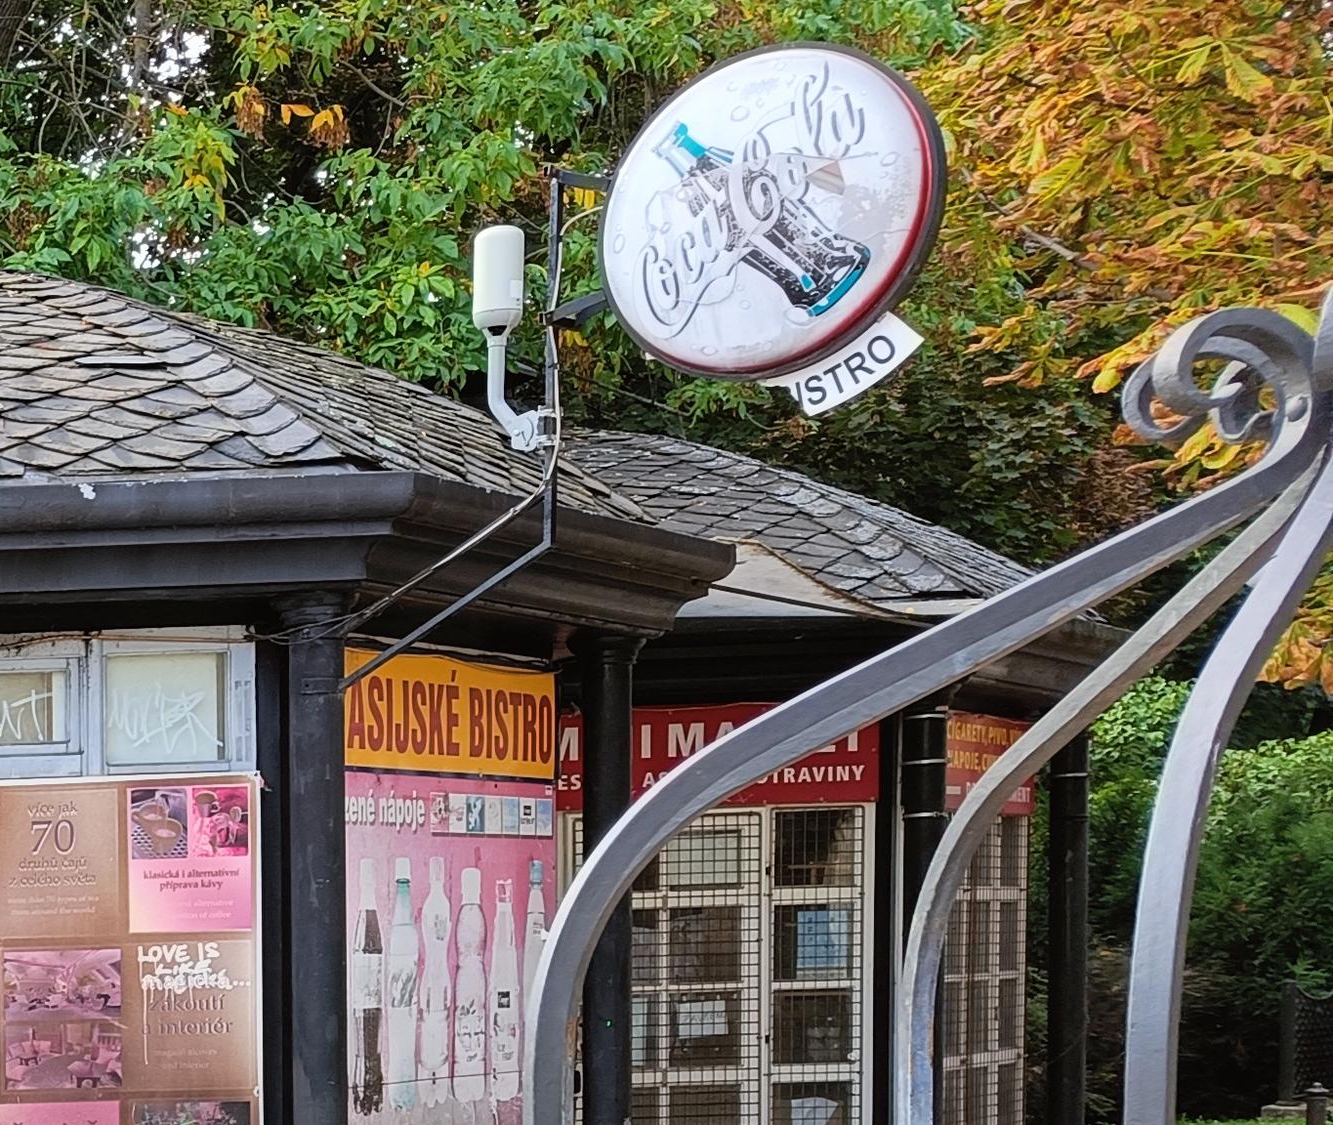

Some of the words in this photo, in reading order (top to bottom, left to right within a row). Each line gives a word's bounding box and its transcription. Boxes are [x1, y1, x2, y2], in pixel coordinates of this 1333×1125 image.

[347, 670, 460, 757] ASIJSKÉ
[469, 687, 553, 764] BISTRO
[58, 801, 78, 819] jak
[379, 790, 427, 833] nápoje
[31, 819, 76, 855] 70
[143, 869, 180, 879] klasická
[187, 868, 240, 879] alternativní
[159, 880, 199, 892] příprava
[200, 879, 223, 890] kávy
[137, 943, 191, 962] LOVE
[197, 942, 220, 961] IS
[149, 994, 226, 1012] zákoutí
[159, 1017, 233, 1035] interiér
